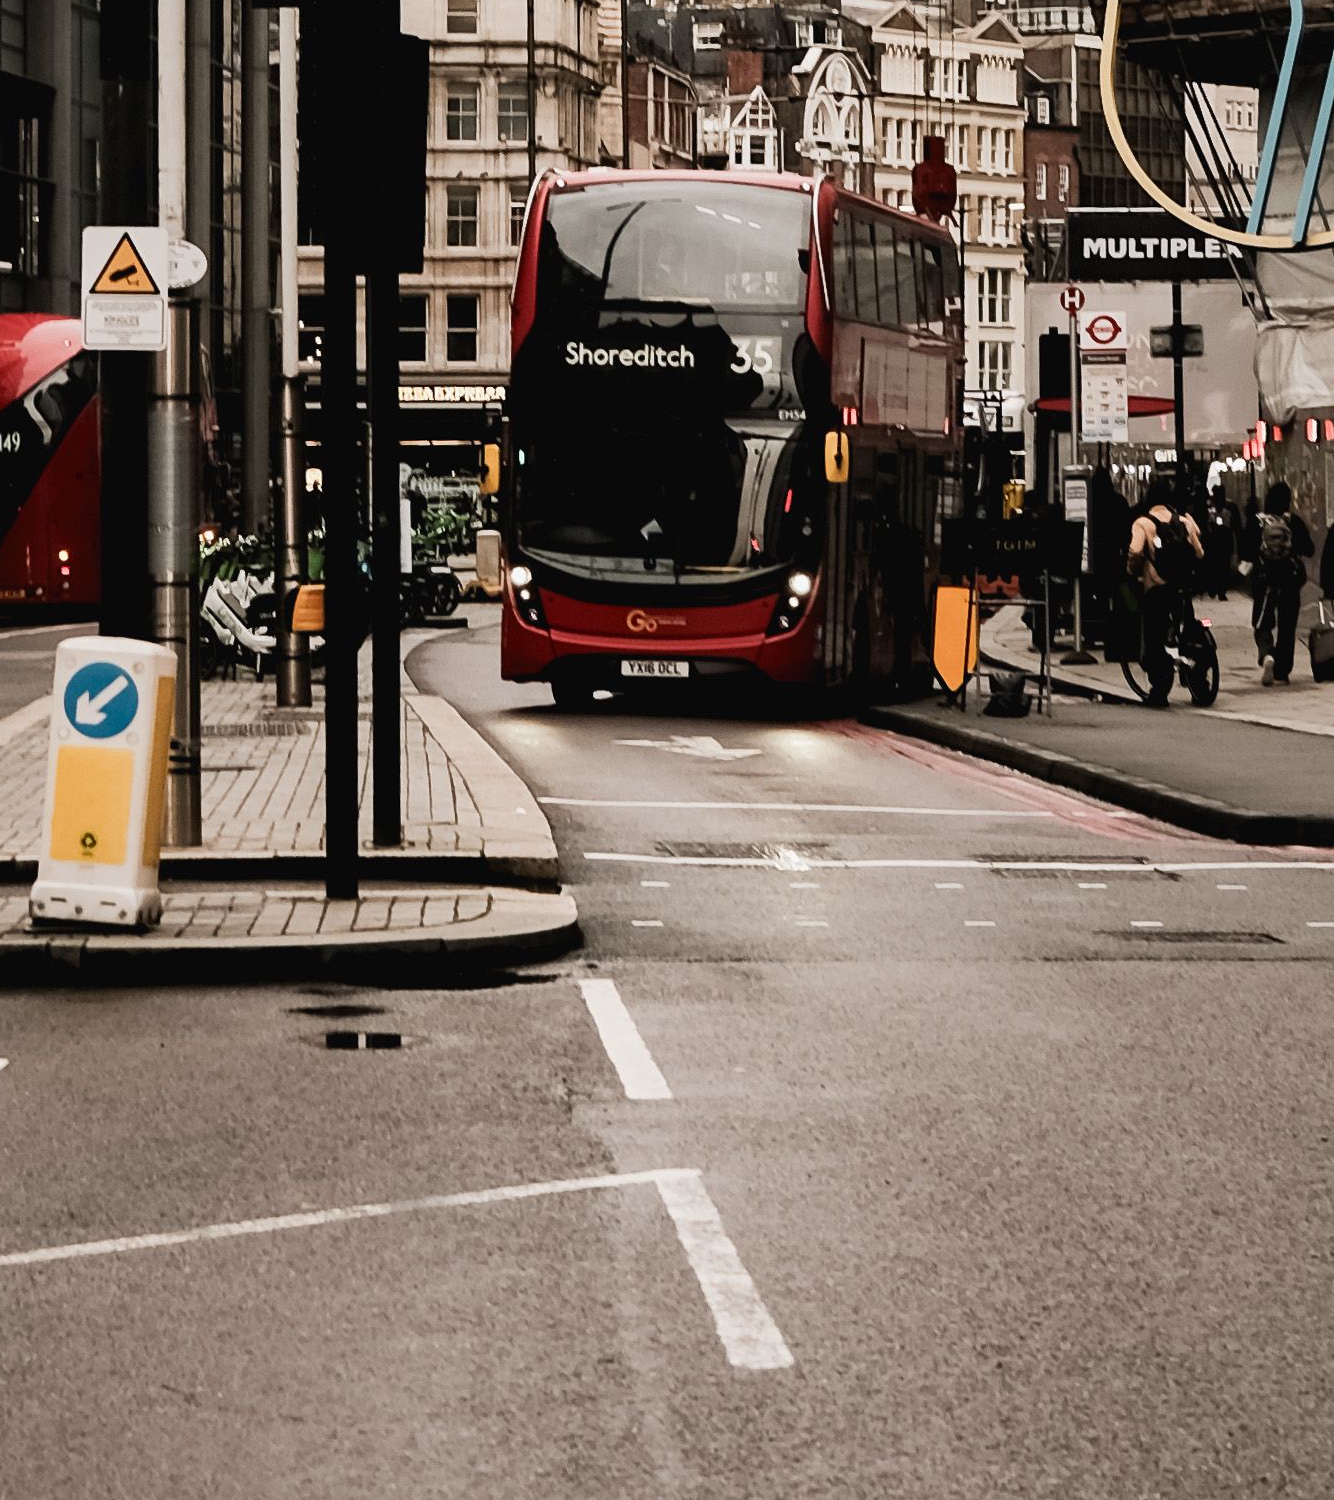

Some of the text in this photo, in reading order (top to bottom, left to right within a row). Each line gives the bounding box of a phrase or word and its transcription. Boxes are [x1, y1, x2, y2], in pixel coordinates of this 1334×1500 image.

[1064, 289, 1080, 309] H
[565, 337, 774, 375] Shoreditch 35
